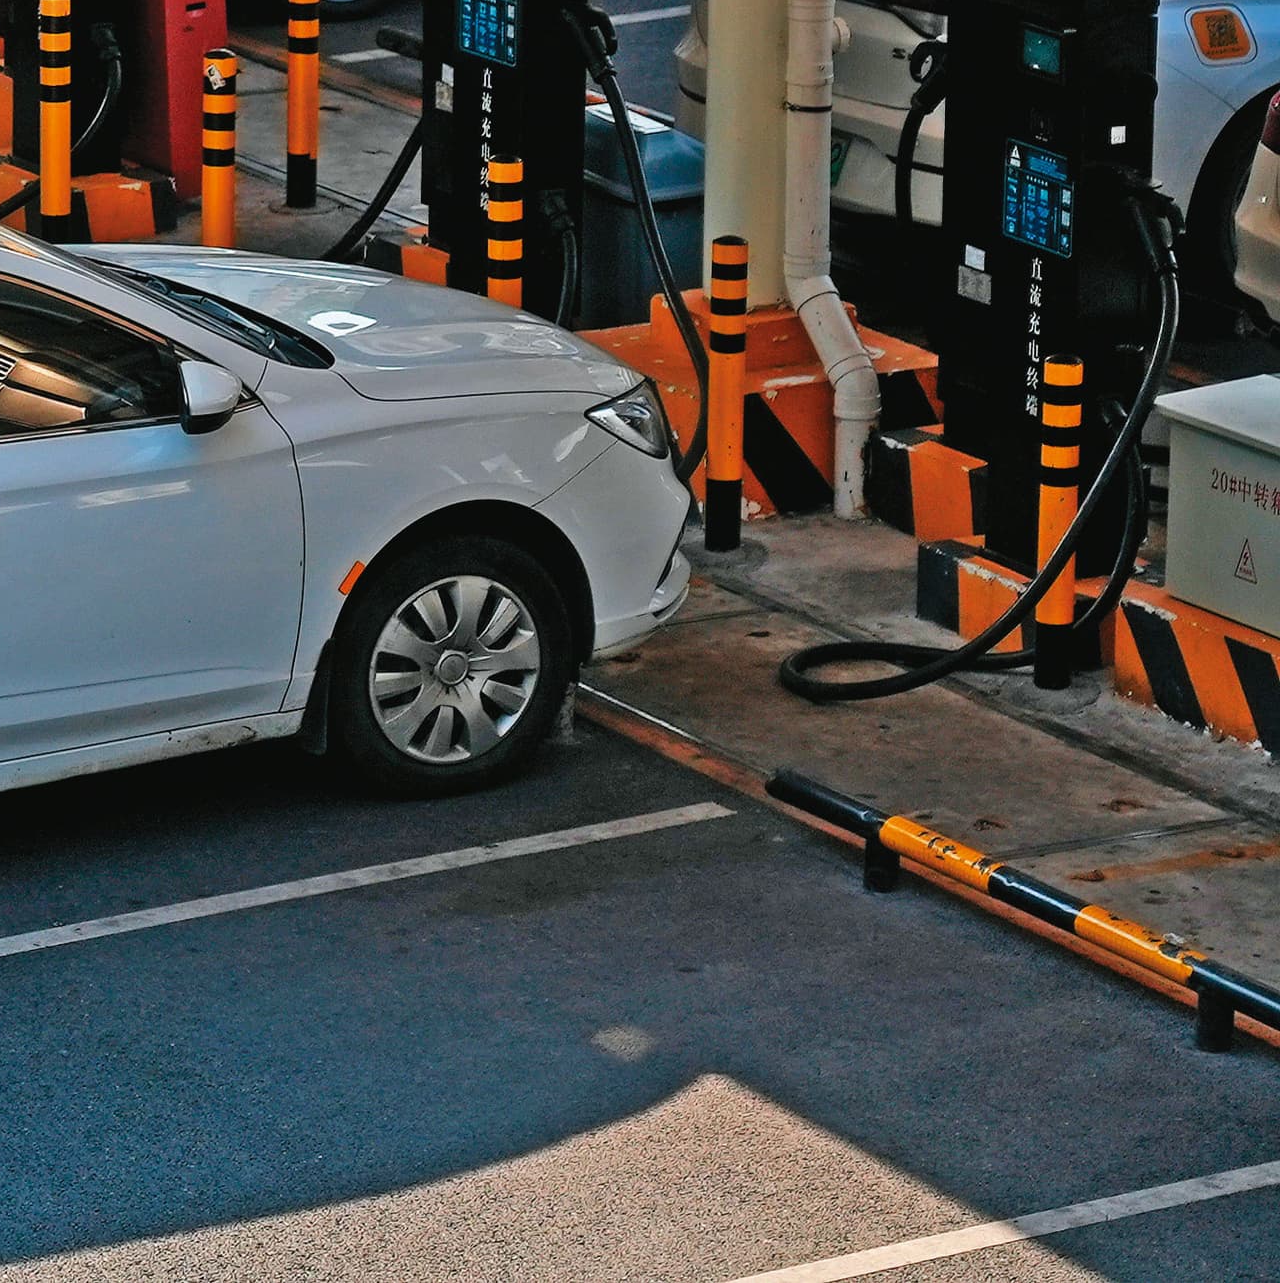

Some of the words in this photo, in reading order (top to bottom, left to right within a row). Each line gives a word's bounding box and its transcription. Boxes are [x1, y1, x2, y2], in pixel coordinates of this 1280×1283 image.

[1026, 257, 1043, 418] 直流充电终端
